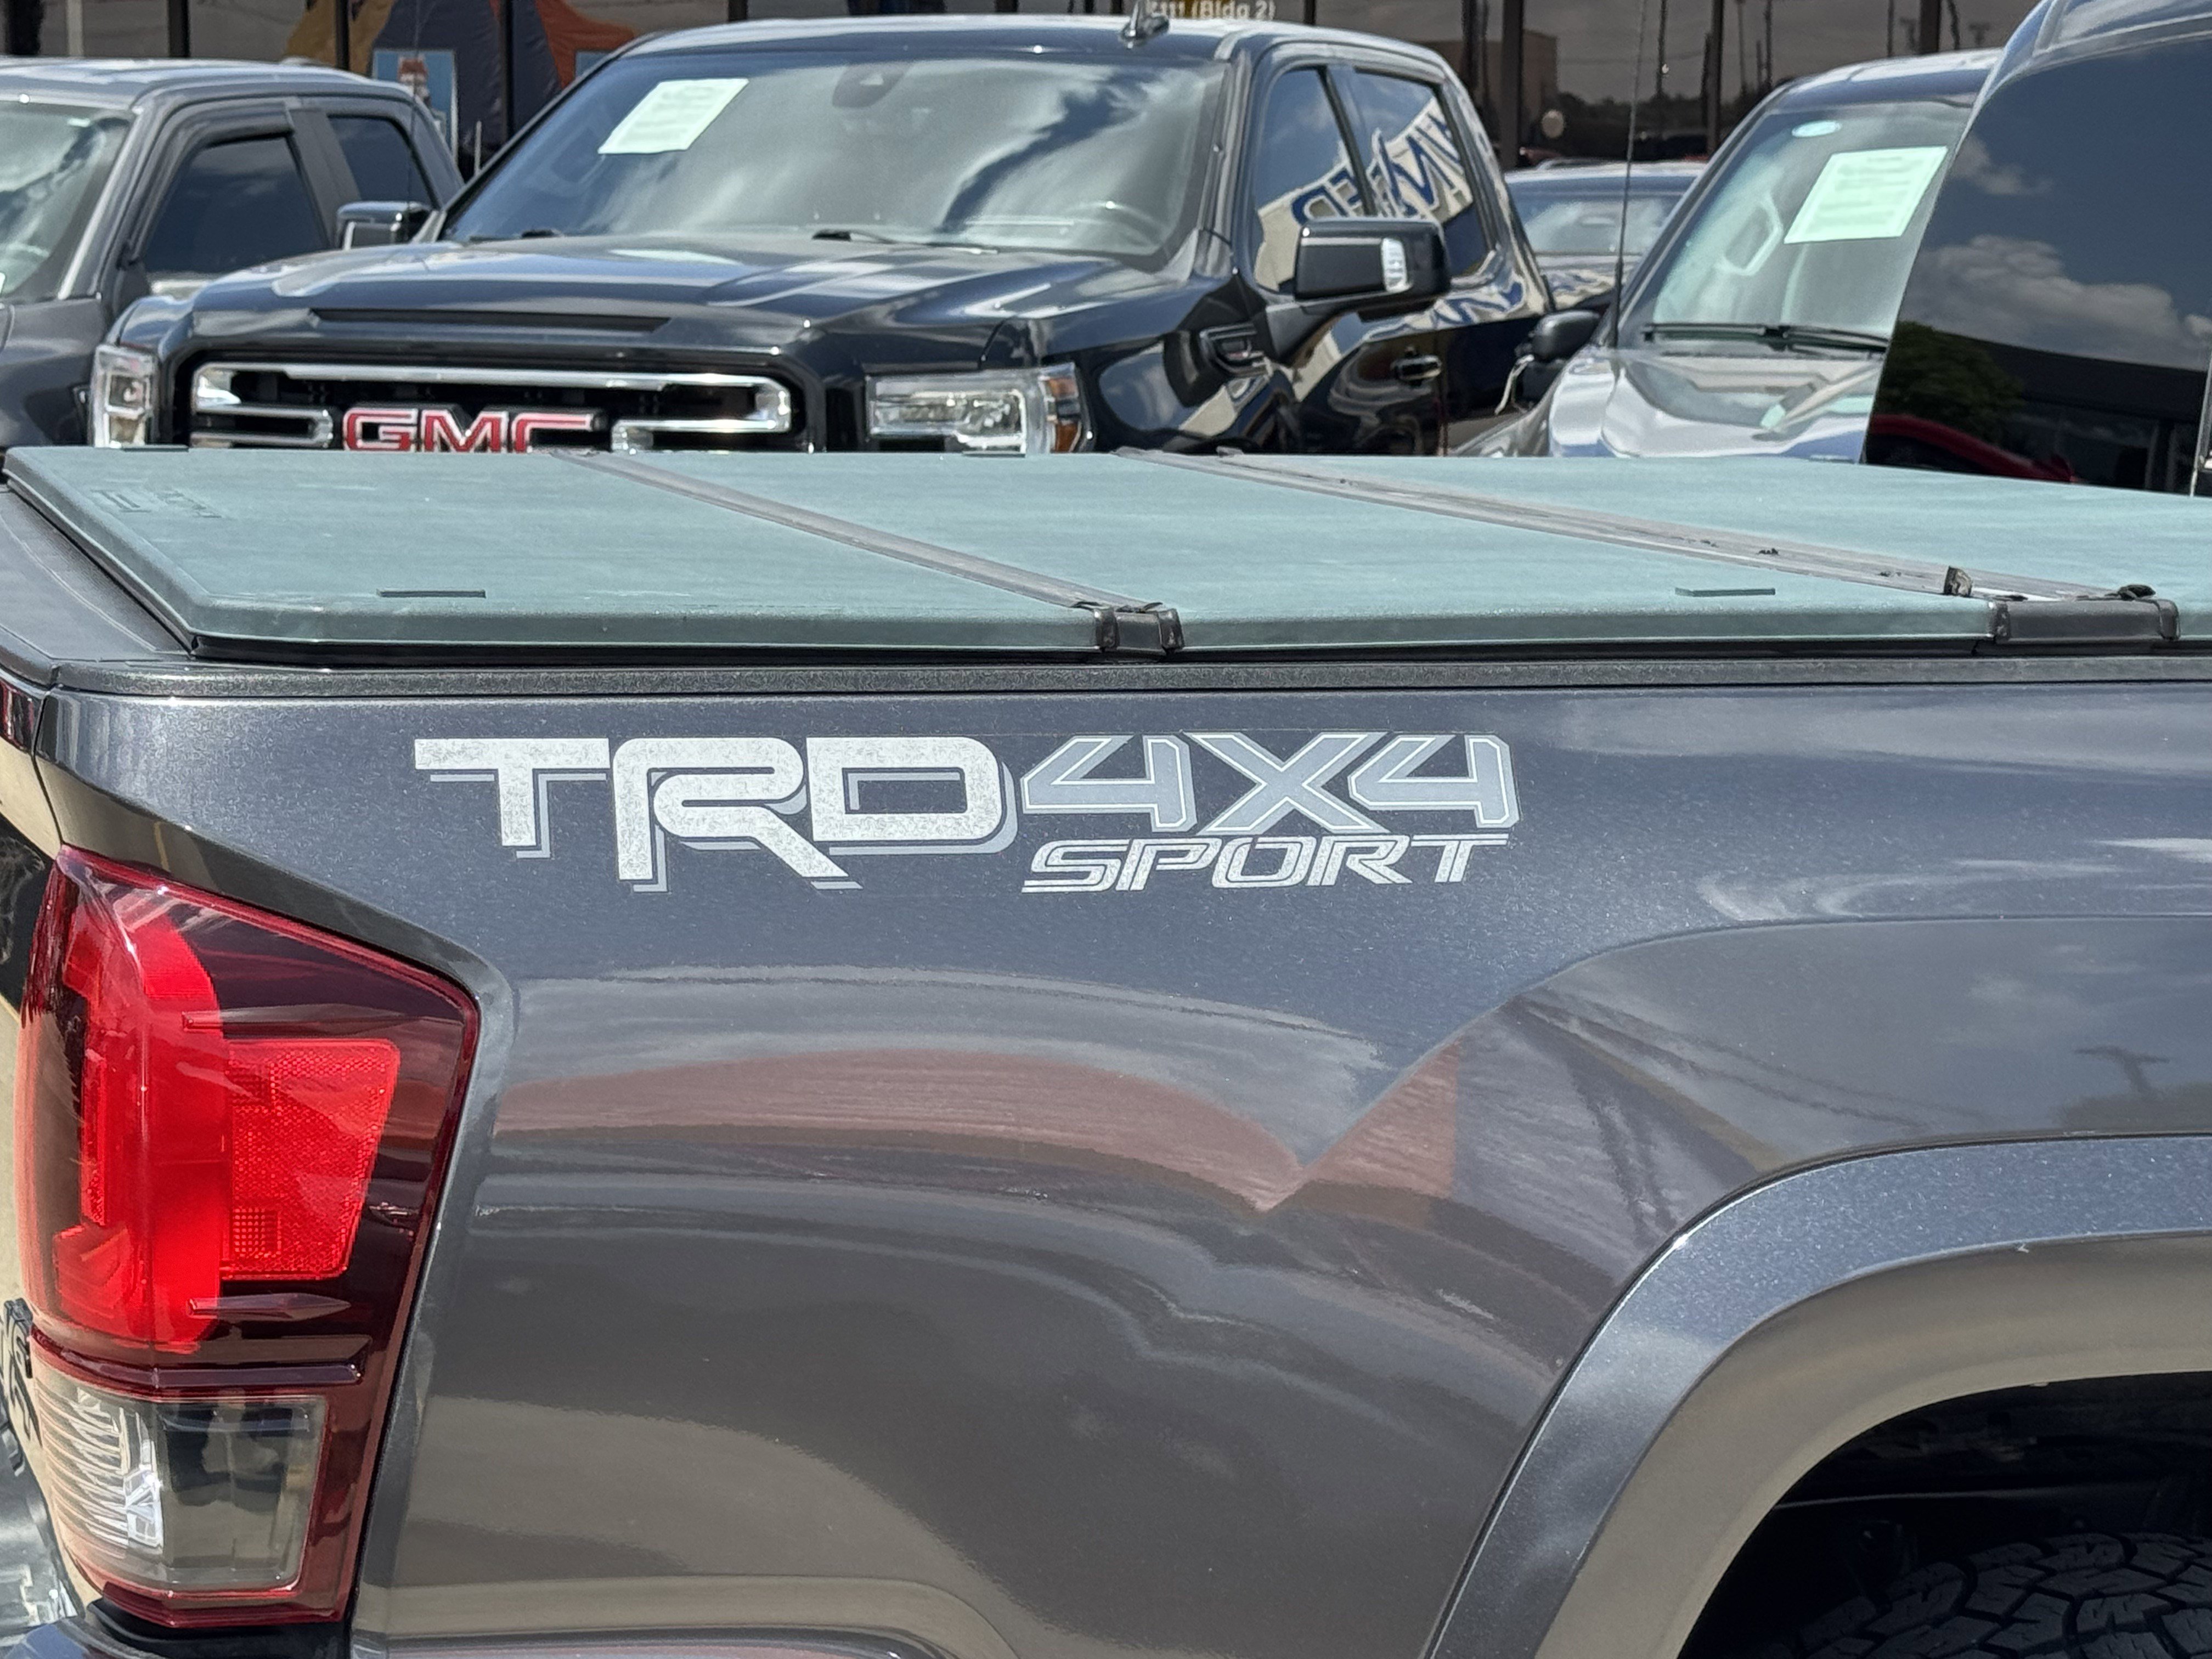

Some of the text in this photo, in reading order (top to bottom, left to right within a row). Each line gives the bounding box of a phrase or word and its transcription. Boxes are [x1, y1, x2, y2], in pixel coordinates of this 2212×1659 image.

[342, 405, 595, 453] GMC
[414, 736, 1018, 892] TRD
[1022, 833, 1509, 894] SPORT
